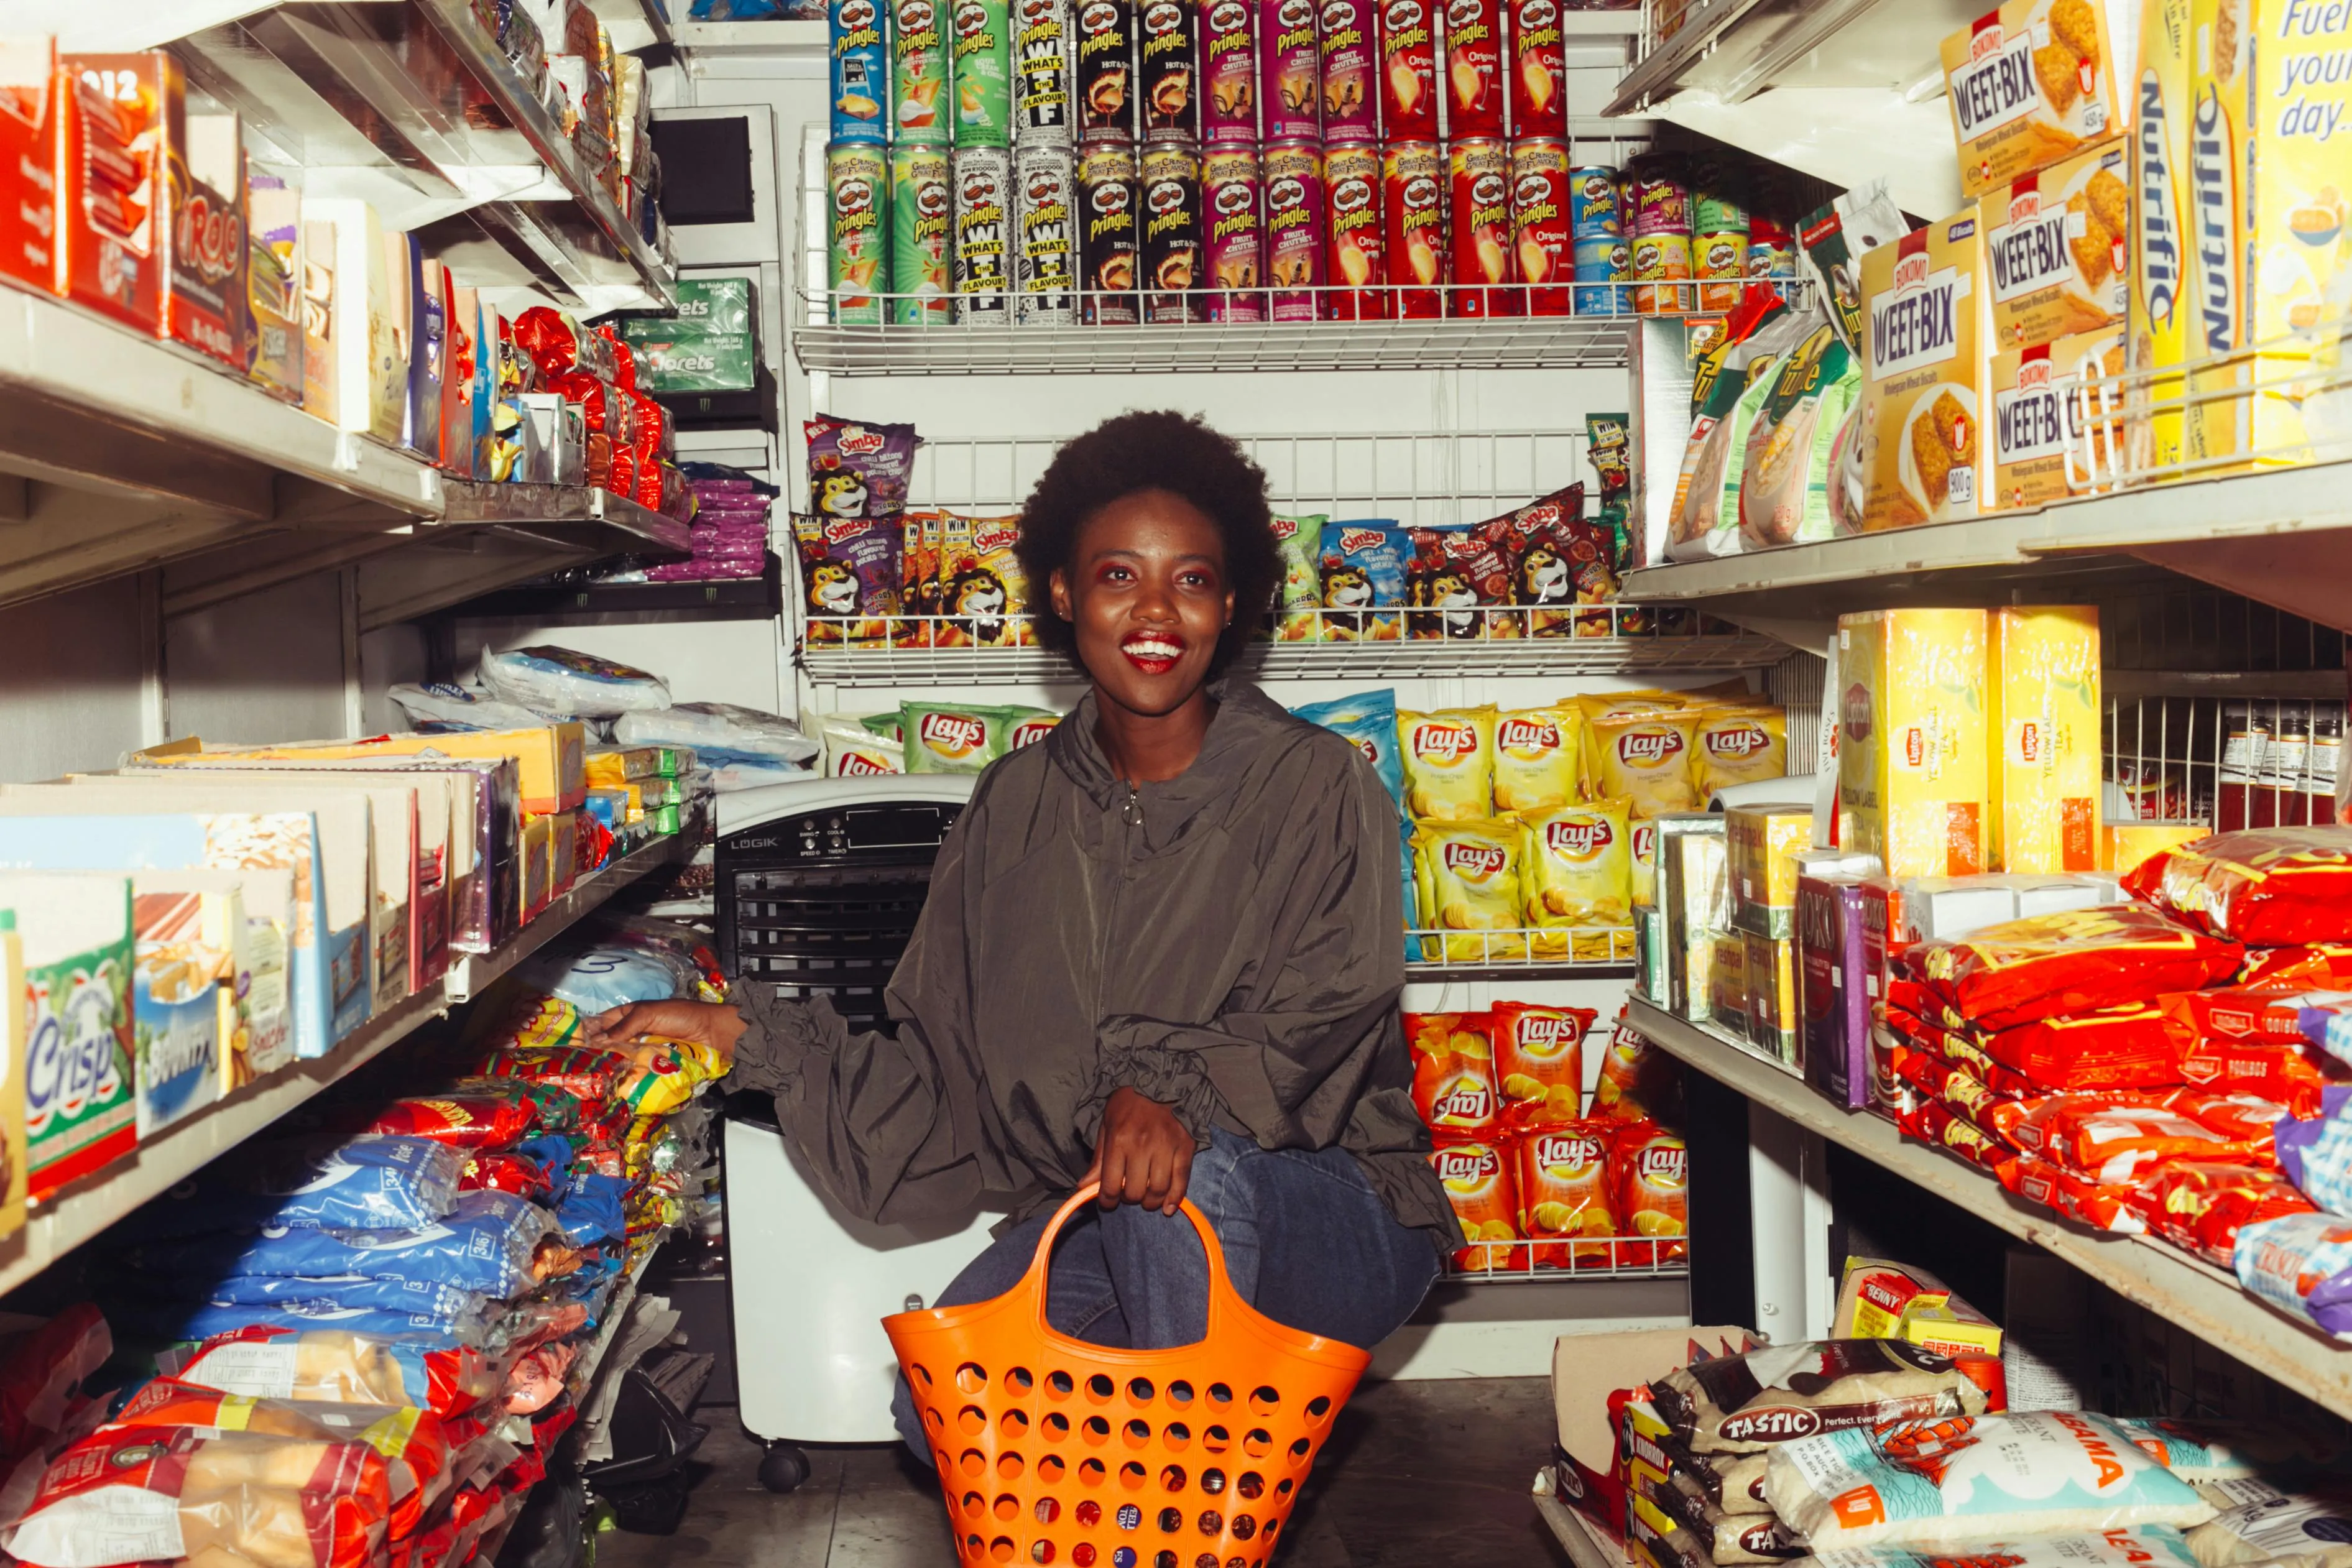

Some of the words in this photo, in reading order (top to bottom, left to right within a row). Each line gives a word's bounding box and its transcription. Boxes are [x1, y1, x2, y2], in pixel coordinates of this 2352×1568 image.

[2282, 0, 2352, 37] Fuel
[837, 27, 880, 59] Pringles
[897, 27, 939, 62] Pringles
[954, 30, 994, 65] Pringles
[1019, 19, 1062, 55] Pringles
[1081, 32, 1123, 64] Pringles
[1144, 33, 1186, 64] Pringles
[1210, 29, 1251, 63] Pringles
[1322, 27, 1362, 62] Pringles
[1385, 25, 1428, 62] Pringles
[1448, 21, 1488, 58] Pringles
[1519, 25, 1560, 59] Pringles
[1023, 57, 1063, 72] WHAT'S
[1227, 53, 1248, 62] FRUIT
[1330, 56, 1364, 71] CHUTNEY
[1335, 50, 1357, 62] FRUIT
[1469, 52, 1497, 62] Original
[1024, 93, 1066, 108] FLAVOUR?
[1953, 46, 2036, 131] WEET-BIX
[1582, 196, 1613, 222] Pringles
[1641, 185, 1673, 211] Pringles
[2141, 82, 2177, 334] Nutrific
[834, 211, 877, 243] Pringles
[959, 204, 1003, 238] Pringles
[1024, 201, 1068, 238] Pringles
[1091, 210, 1133, 242] Pringles
[1148, 210, 1191, 243] Pringles
[1214, 210, 1256, 244] Pringles
[1270, 206, 1310, 239] Pringles
[1334, 208, 1375, 241] Pringles
[1516, 201, 1557, 229] Pringles
[2193, 81, 2230, 352] Nutrific
[190, 196, 239, 275] Rolo
[962, 242, 1003, 256] WHAT'S
[1028, 241, 1069, 255] WHAT'S
[1232, 235, 1253, 243] FRUIT
[1278, 236, 1312, 249] CHUTNEY
[1283, 230, 1306, 239] FRUIT
[1536, 231, 1567, 241] Original
[1991, 216, 2069, 290] WEET-BIX
[964, 277, 1006, 291] FLAVOUR?
[1030, 277, 1072, 290] FLAVOUR?
[1896, 259, 1927, 290] BOKOMO
[1872, 283, 1954, 368] WEET-BIX
[650, 351, 714, 372] Clorets
[2019, 364, 2050, 390] BOKOMO
[806, 423, 831, 438] NEW
[839, 433, 883, 453] Simba
[1597, 422, 1616, 433] WIN
[1950, 471, 1963, 494] 900
[1965, 475, 1972, 497] g
[828, 519, 870, 542] Simba
[948, 520, 966, 532] WIN
[1517, 507, 1557, 532] Simba
[977, 530, 1019, 550] Simba
[1342, 531, 1385, 553] Simba
[923, 713, 985, 752] Lay's
[1418, 725, 1473, 761] Lay's
[1501, 720, 1556, 754] Lay's
[1623, 731, 1679, 762] Lay's
[1711, 727, 1764, 755] Lay's
[1909, 730, 1920, 765] Lipton
[2024, 724, 2035, 760] Lipton
[2054, 731, 2063, 750] TEA
[731, 839, 778, 850] LOGIK
[1551, 822, 1607, 855] Lay's
[1449, 842, 1503, 877] Lay's
[1521, 1015, 1574, 1051] Lay's
[27, 1015, 114, 1110] Crisp
[1438, 1152, 1494, 1186] Lay's
[1542, 1137, 1598, 1171] Lay's
[1866, 1283, 1901, 1309] BENNY
[1726, 1411, 1809, 1438] TASTIC
[1825, 1416, 1856, 1427] Perfect.
[1636, 1435, 1666, 1471] KNORROX
[1807, 1442, 1815, 1452] 40
[1815, 1437, 1830, 1456] RICE
